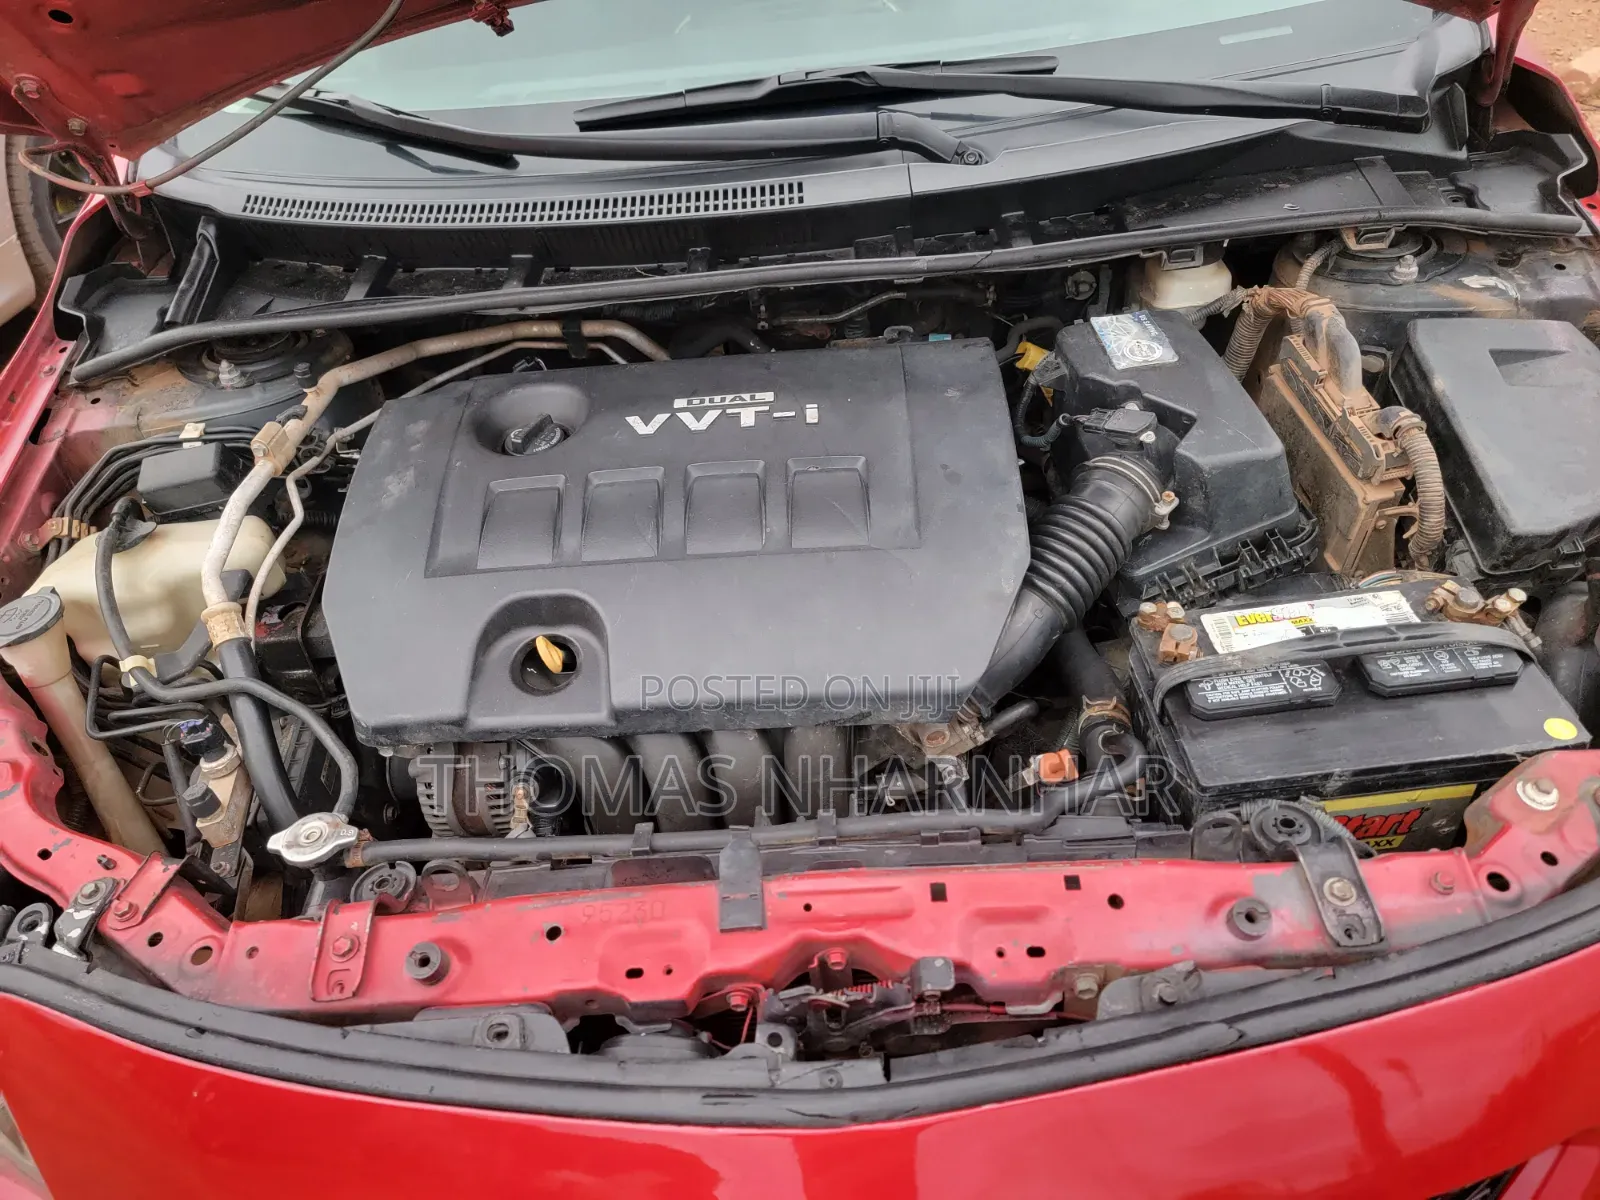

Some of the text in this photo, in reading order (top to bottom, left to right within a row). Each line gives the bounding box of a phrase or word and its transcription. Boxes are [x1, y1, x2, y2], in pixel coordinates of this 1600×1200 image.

[686, 393, 767, 406] DUAL
[624, 403, 820, 436] VVT-i
[1290, 617, 1313, 625] MAXX
[582, 900, 665, 925] 95230
